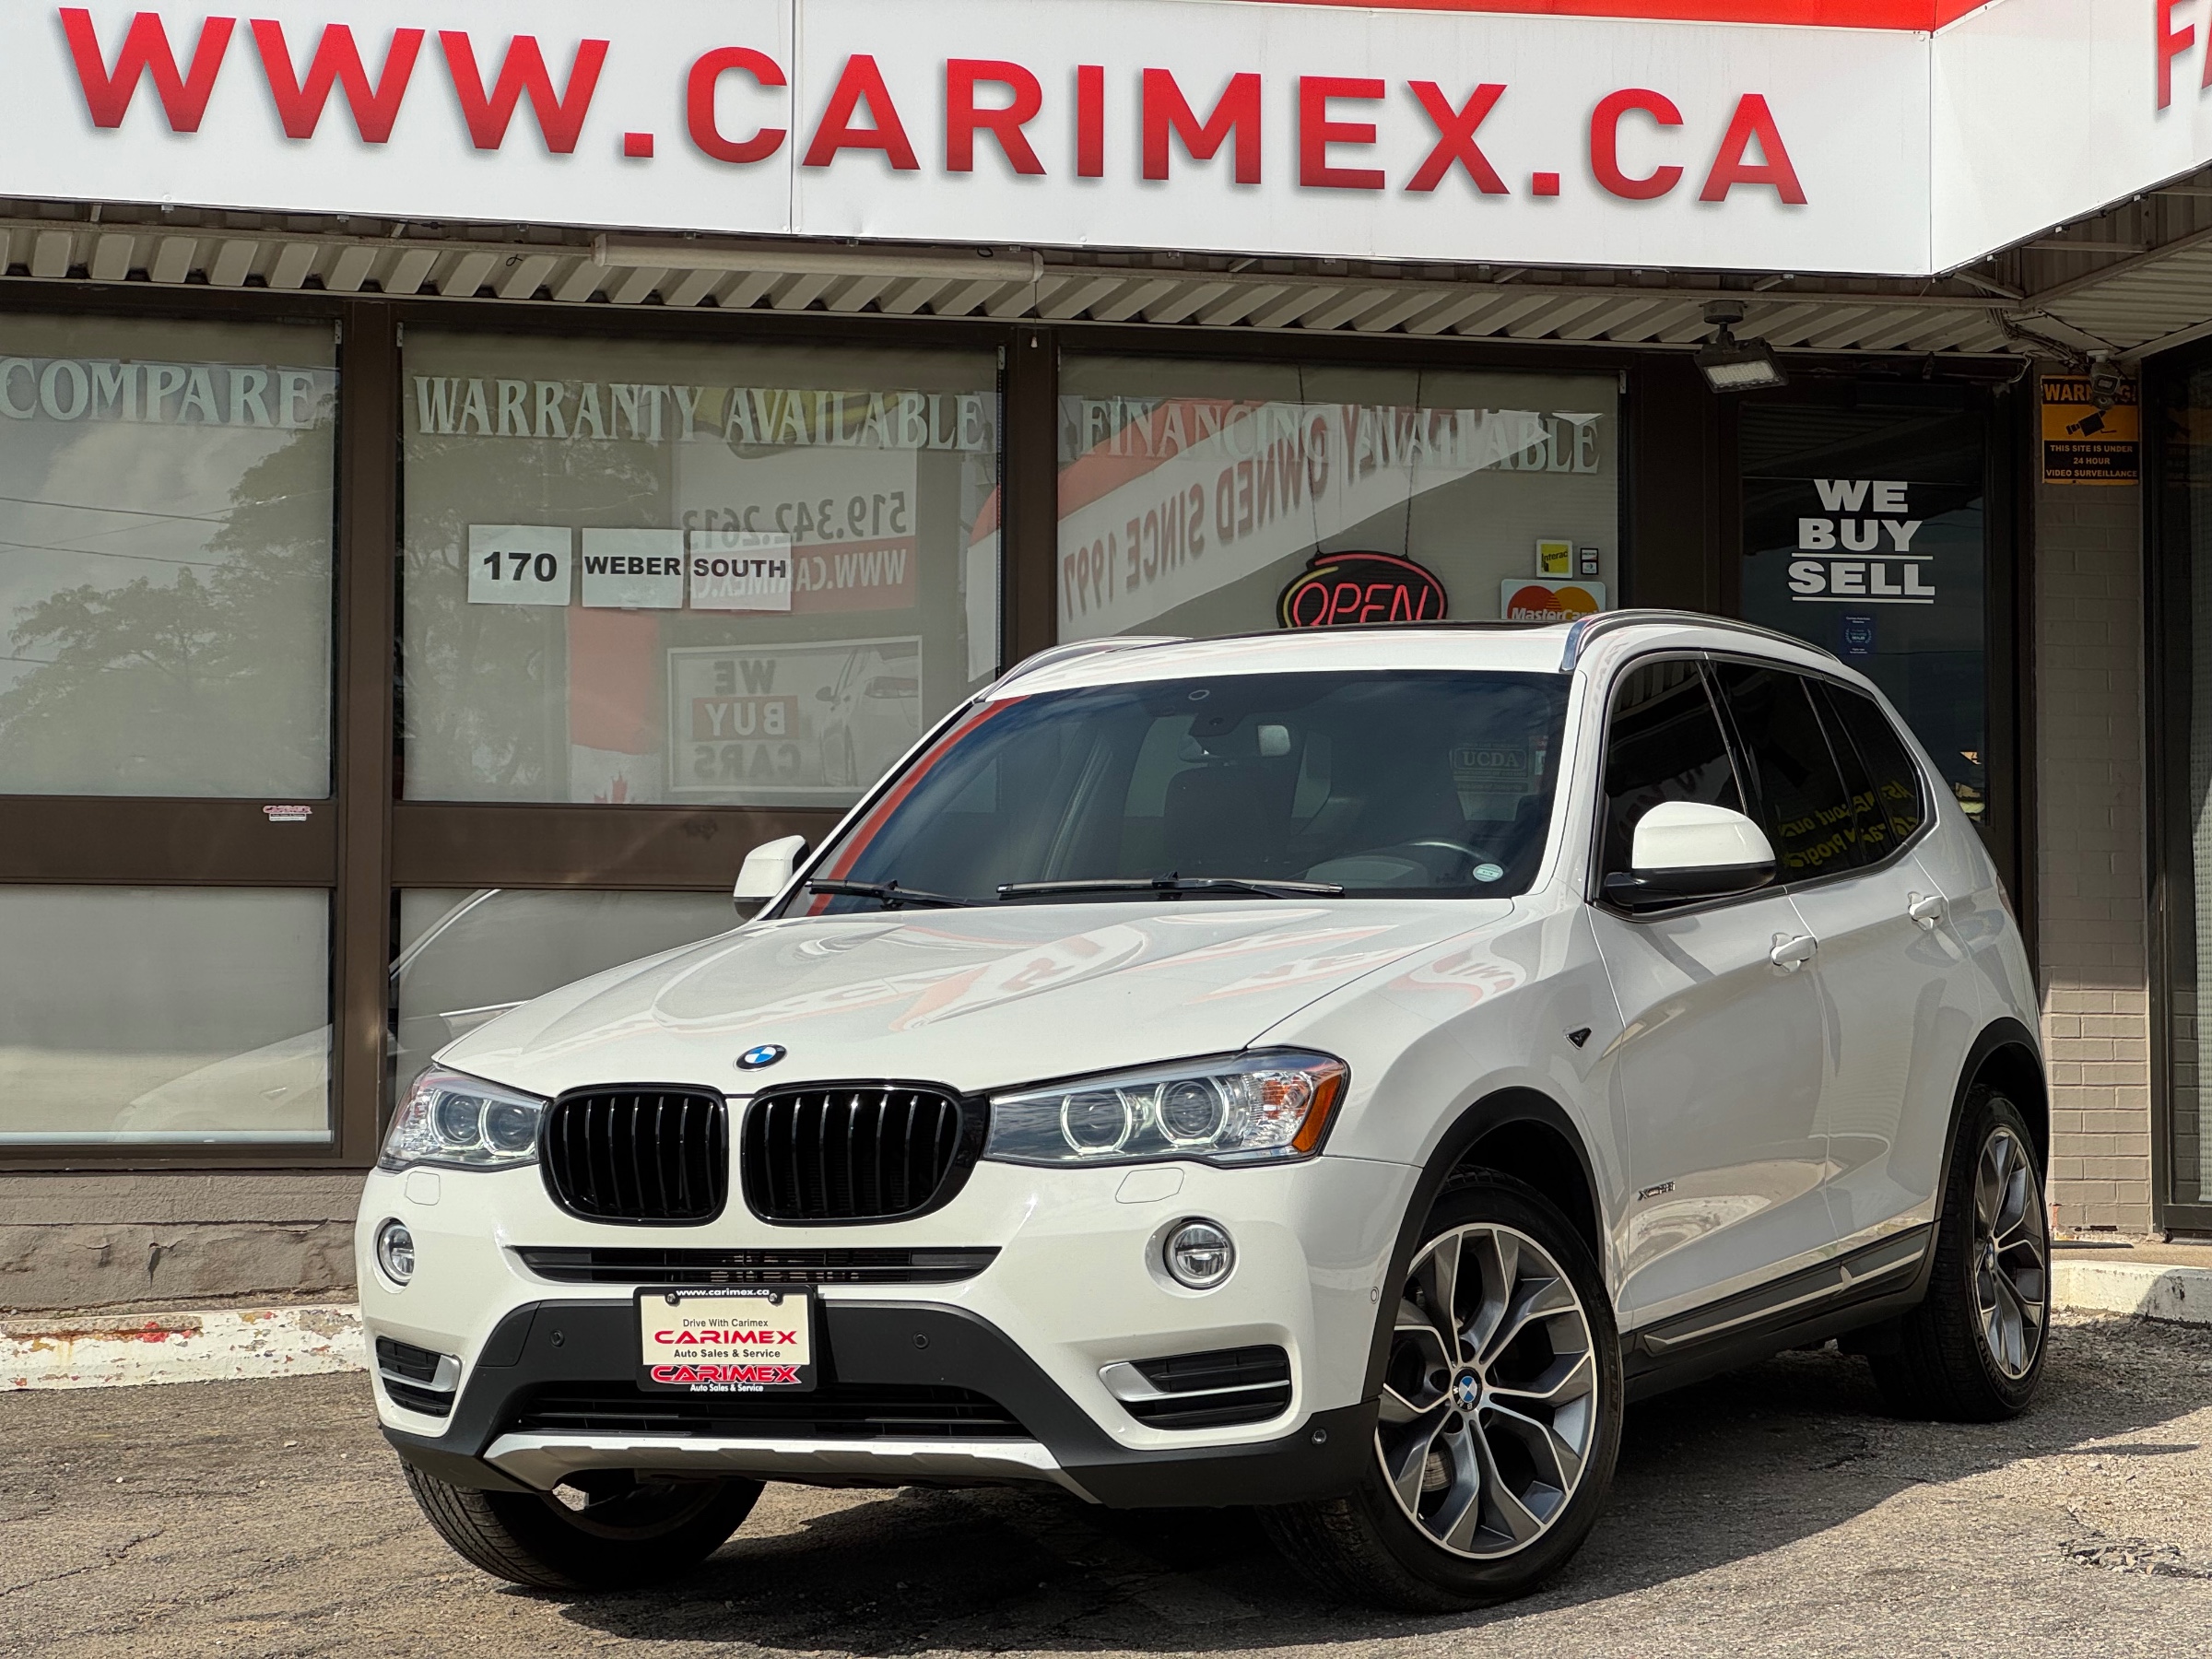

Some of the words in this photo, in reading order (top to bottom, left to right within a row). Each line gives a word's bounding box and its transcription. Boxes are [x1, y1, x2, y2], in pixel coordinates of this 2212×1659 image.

[57, 6, 1807, 206] WWW.CARIMEX.CA
[0, 357, 315, 429] COMPARE
[2043, 383, 2136, 403] WARG!
[413, 376, 704, 442] WARRANTY
[723, 387, 985, 451] AVAILABLE
[1081, 399, 1327, 463] FINANCING
[1357, 412, 1601, 474] AVAILABLE
[2050, 444, 2070, 453] THIS
[2072, 444, 2091, 453] SITE
[2093, 444, 2101, 453] IS
[2104, 444, 2133, 453] UNDER
[2074, 469, 2137, 477] SURVEILLANCE
[1813, 478, 1909, 512] WE
[1798, 518, 1923, 552] BUY
[482, 551, 558, 582] 170
[584, 555, 681, 576] WEBER
[693, 558, 786, 578] SOUTH
[1541, 550, 1569, 564] Interac
[1788, 560, 1935, 595] SELL
[1292, 582, 1430, 628] OPEN
[1463, 751, 1519, 767] UCDA
[676, 1288, 771, 1296] www.carimex.ca
[683, 1319, 706, 1327] Drive
[709, 1319, 728, 1327] With
[731, 1319, 769, 1327] Carimex
[654, 1330, 797, 1344] CARIMEX
[674, 1349, 698, 1358] Auto
[700, 1349, 728, 1358] Sales
[732, 1349, 739, 1358] &
[743, 1349, 781, 1358] Service
[651, 1365, 800, 1383] CARIMEX
[690, 1383, 708, 1392] Auto
[710, 1383, 729, 1392] Sales
